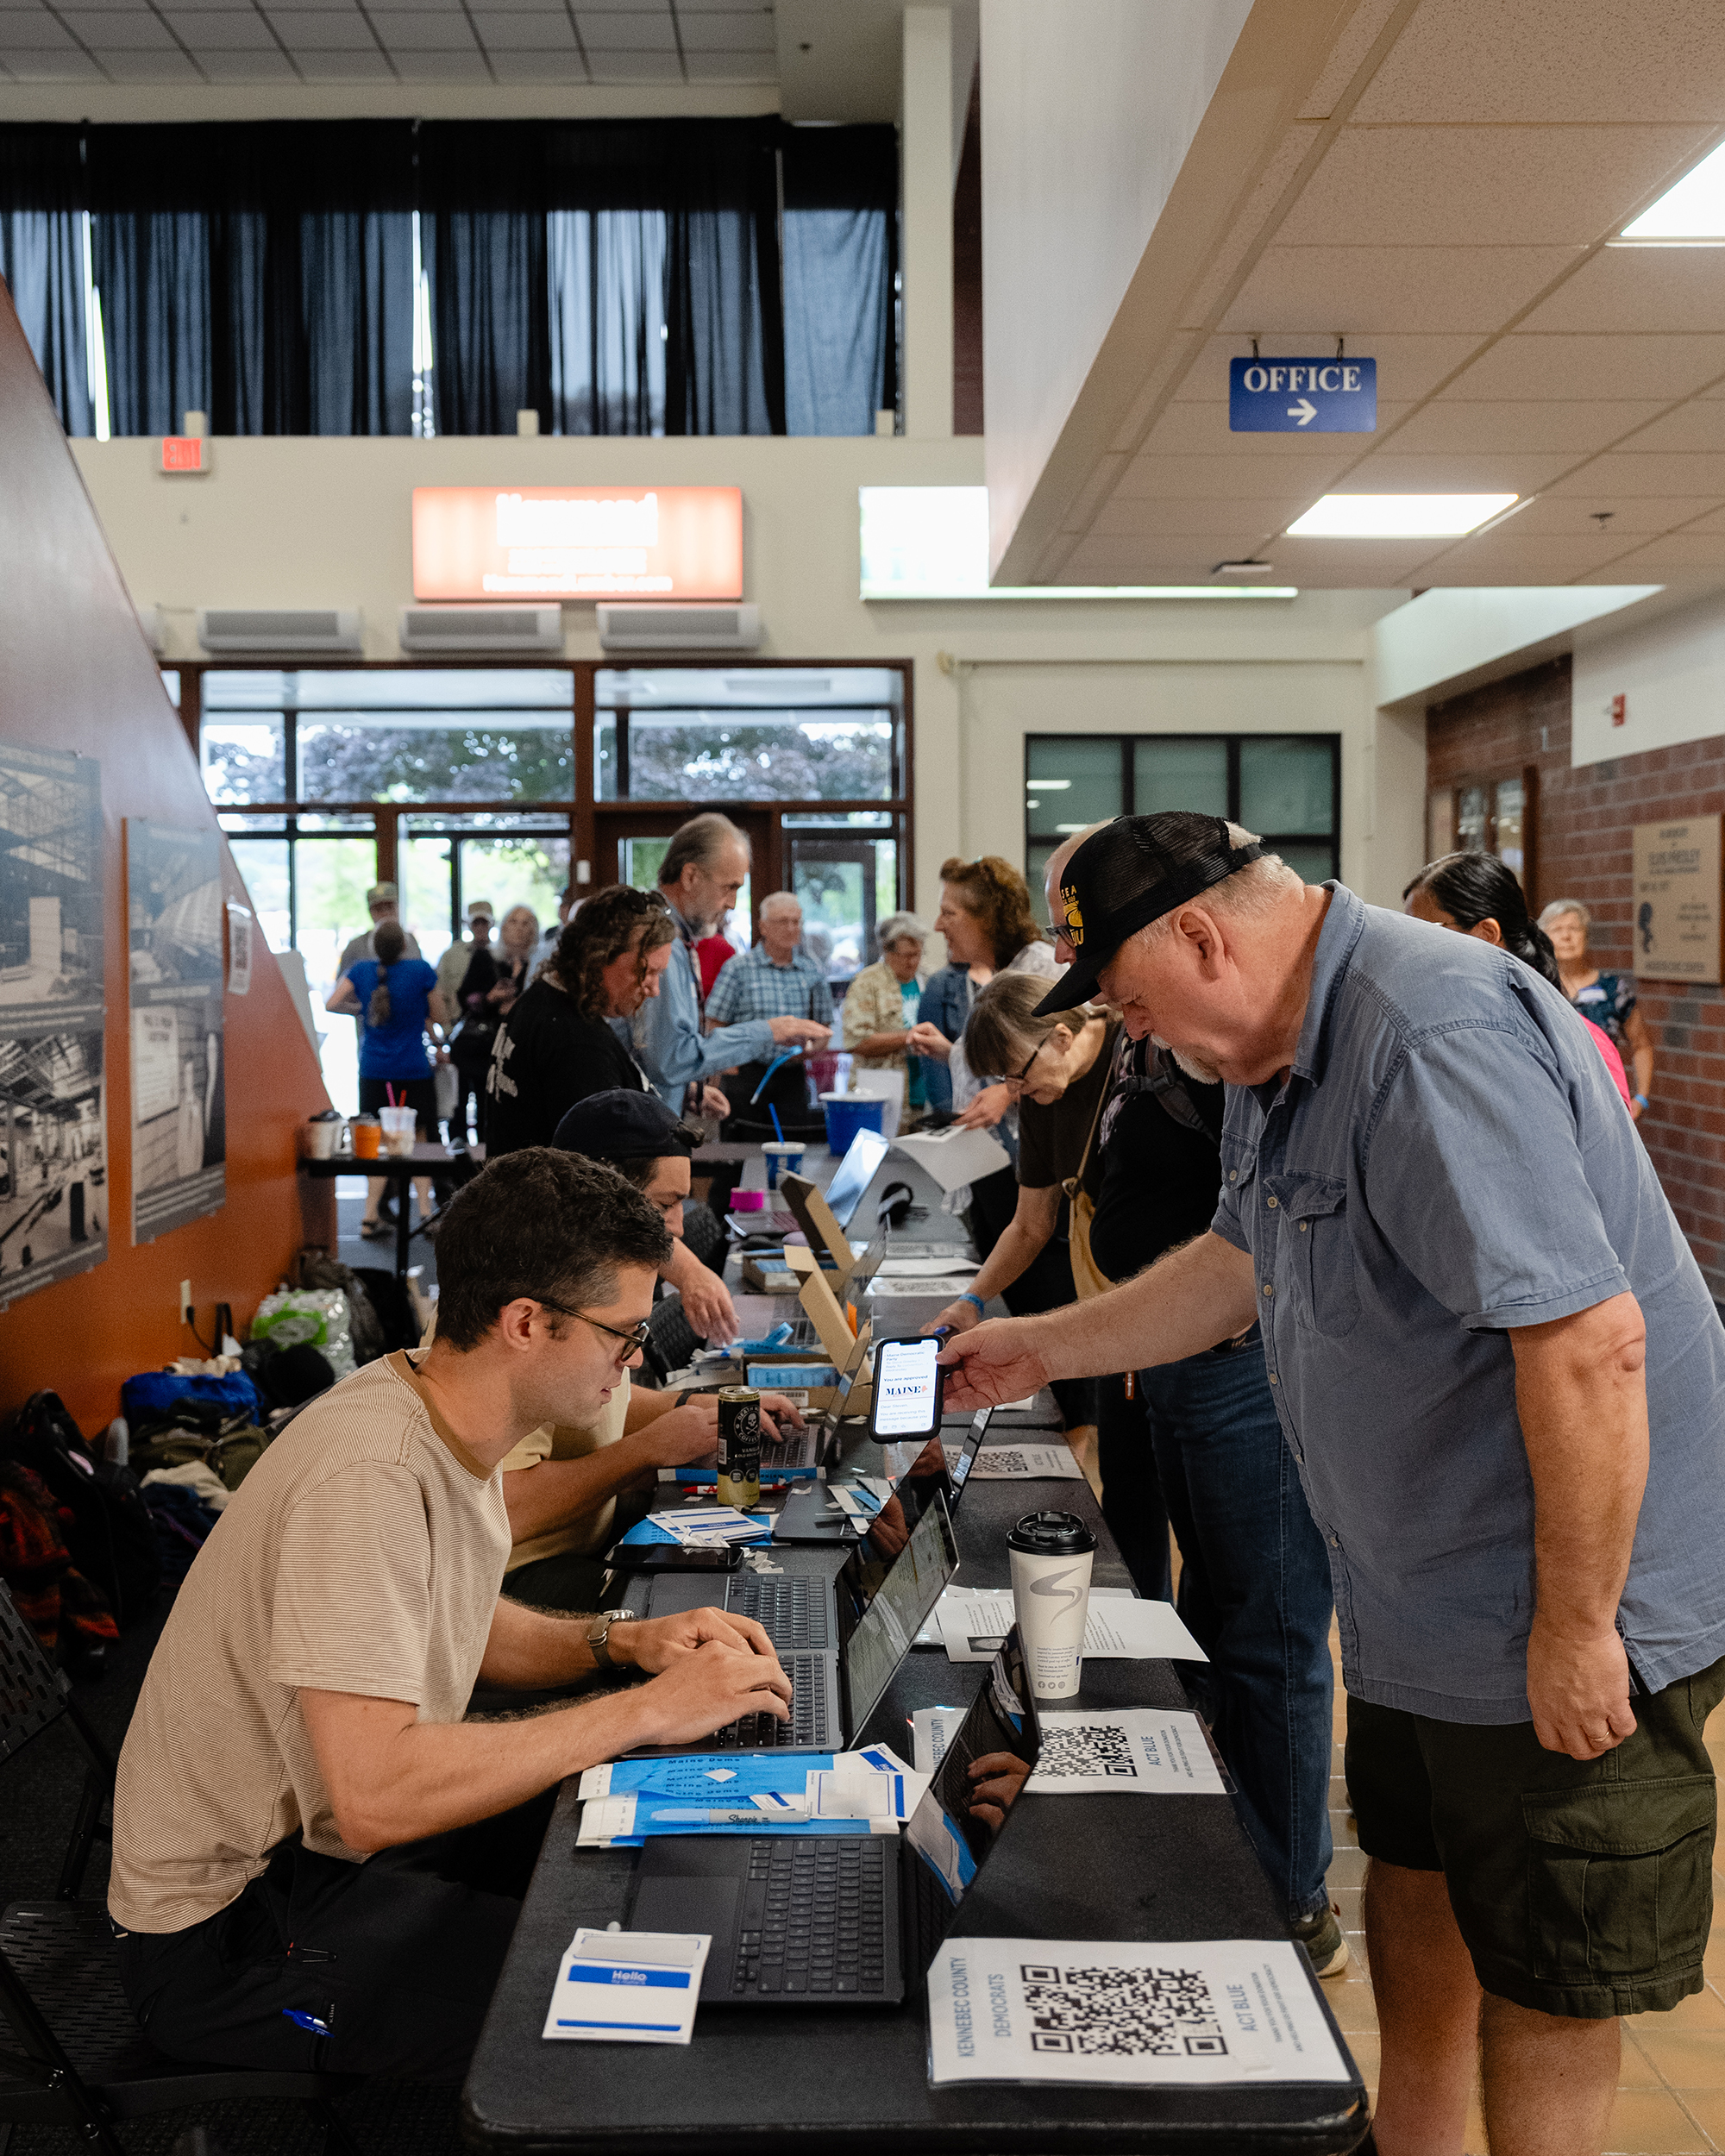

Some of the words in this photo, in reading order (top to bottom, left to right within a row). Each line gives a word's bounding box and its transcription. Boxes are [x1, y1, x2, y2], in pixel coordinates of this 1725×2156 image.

[1244, 367, 1361, 392] OFFICE
[885, 1386, 921, 1395] MAINE
[931, 1719, 944, 1742] COUNTY
[1140, 1736, 1157, 1752] BLUE
[1146, 1753, 1162, 1766] ACT
[728, 1814, 759, 1824] Sharpie
[612, 1970, 648, 1981] Hello
[950, 1957, 969, 1997] COUNTY
[988, 1973, 1012, 2037] DEMOCRATS
[1226, 1984, 1250, 2009] BLUE
[954, 2000, 975, 2057] KENNEBEC
[1236, 2012, 1258, 2031] ACT
